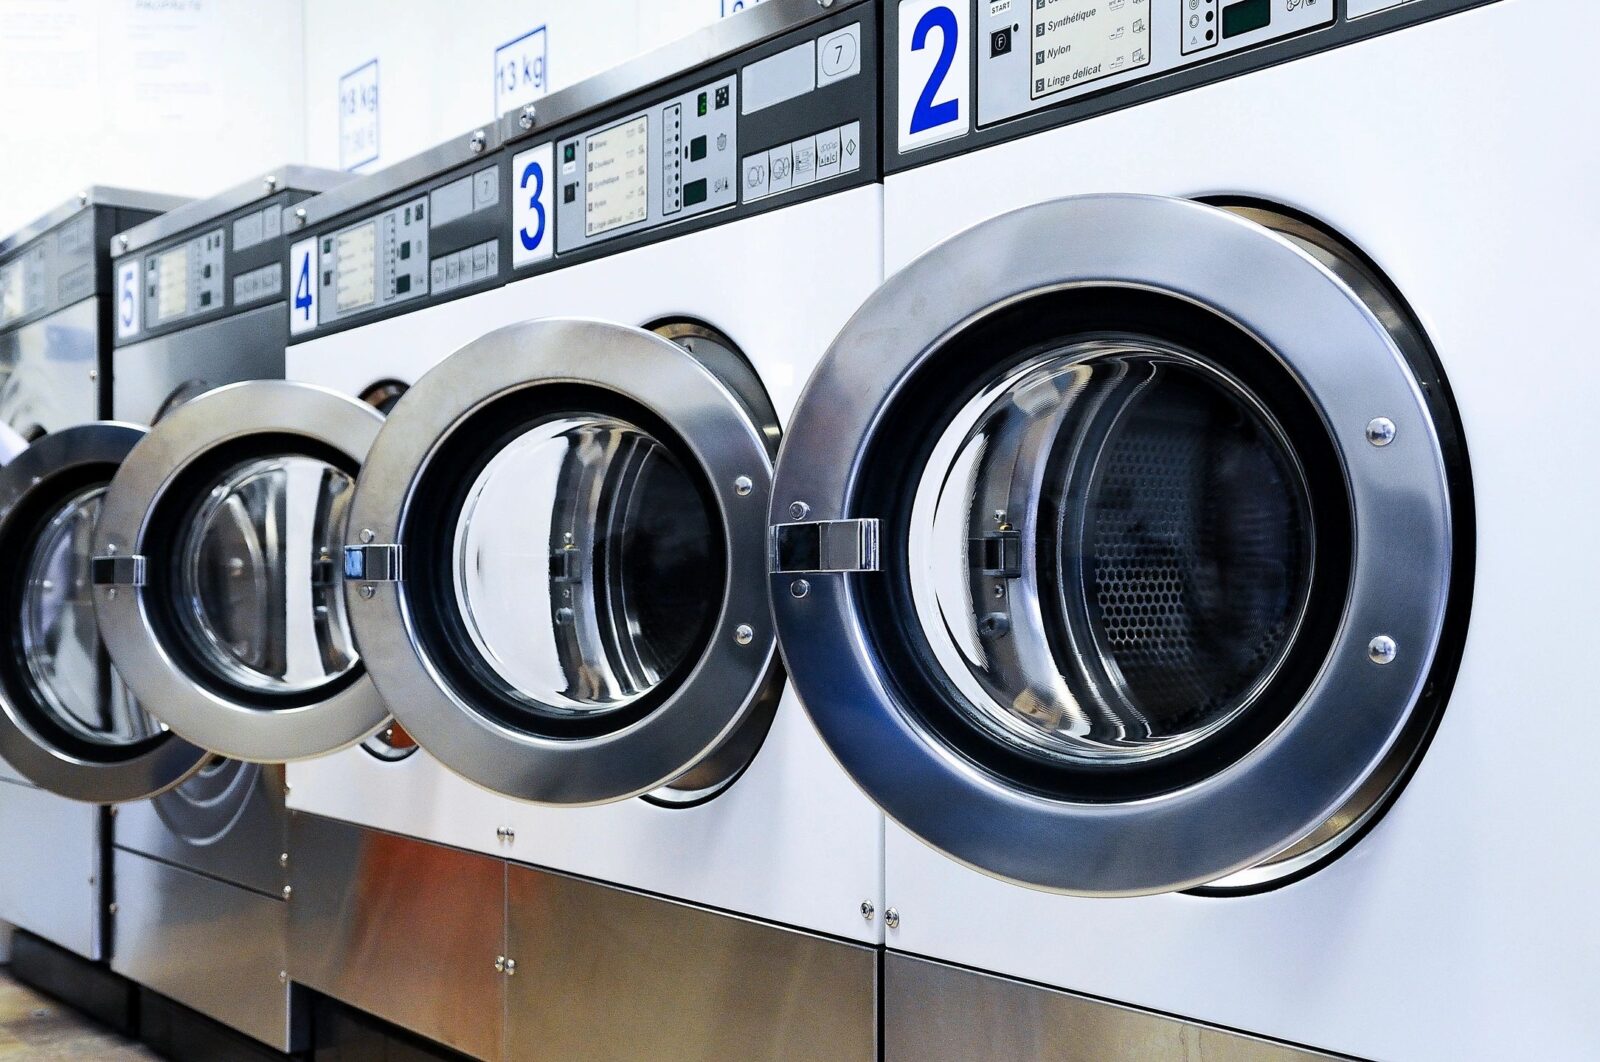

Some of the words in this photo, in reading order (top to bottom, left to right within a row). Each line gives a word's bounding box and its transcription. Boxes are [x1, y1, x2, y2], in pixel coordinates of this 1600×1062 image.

[992, 2, 1010, 14] START
[1047, 8, 1097, 31] Synthétique
[834, 45, 843, 65] 7
[1046, 44, 1071, 59] Nylon
[496, 62, 516, 94] 13
[522, 54, 543, 88] kg
[910, 6, 959, 135] 2
[1047, 74, 1071, 88] Linge
[520, 161, 545, 250] 3
[124, 271, 134, 327] 5
[295, 251, 312, 320] 4
